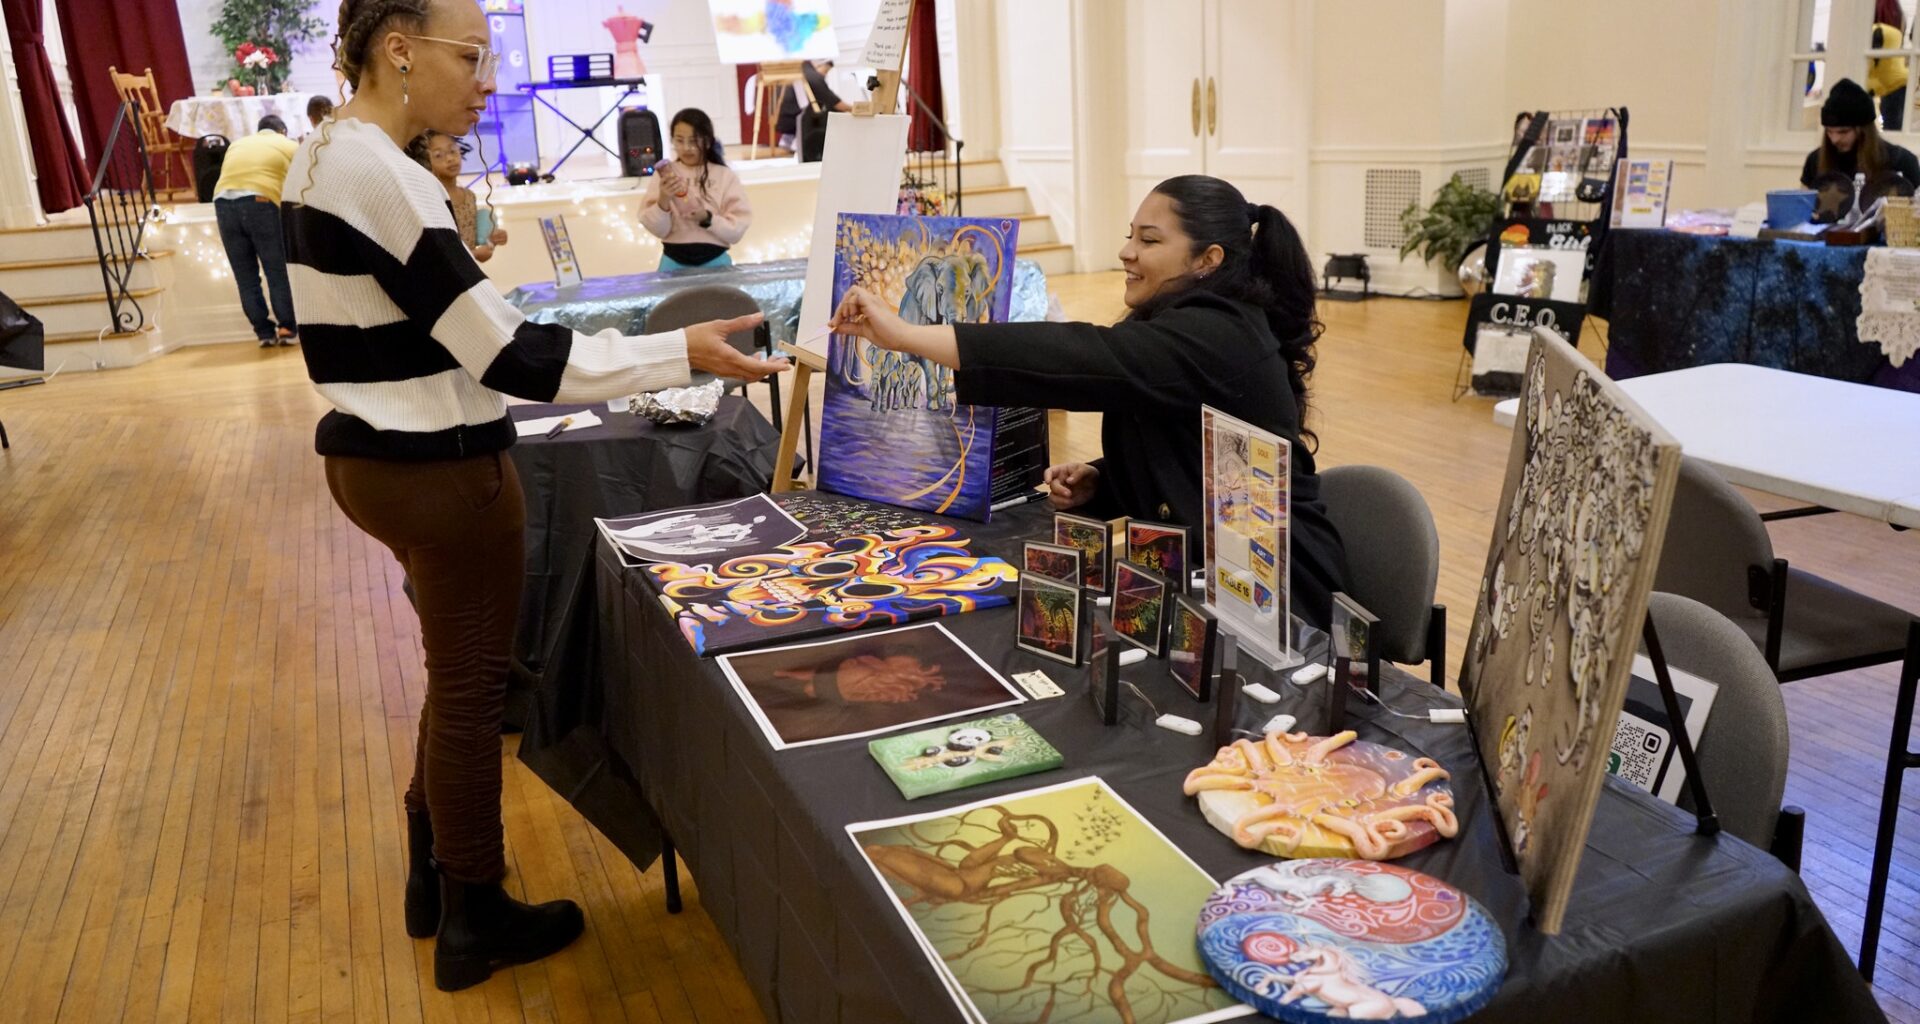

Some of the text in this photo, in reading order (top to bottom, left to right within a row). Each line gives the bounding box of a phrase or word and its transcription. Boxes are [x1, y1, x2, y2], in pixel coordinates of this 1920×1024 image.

[1546, 222, 1573, 234] BLACK
[1549, 233, 1593, 250] Girl
[1490, 302, 1560, 330] C.E.O.
[1220, 571, 1250, 598] TABLE 15
